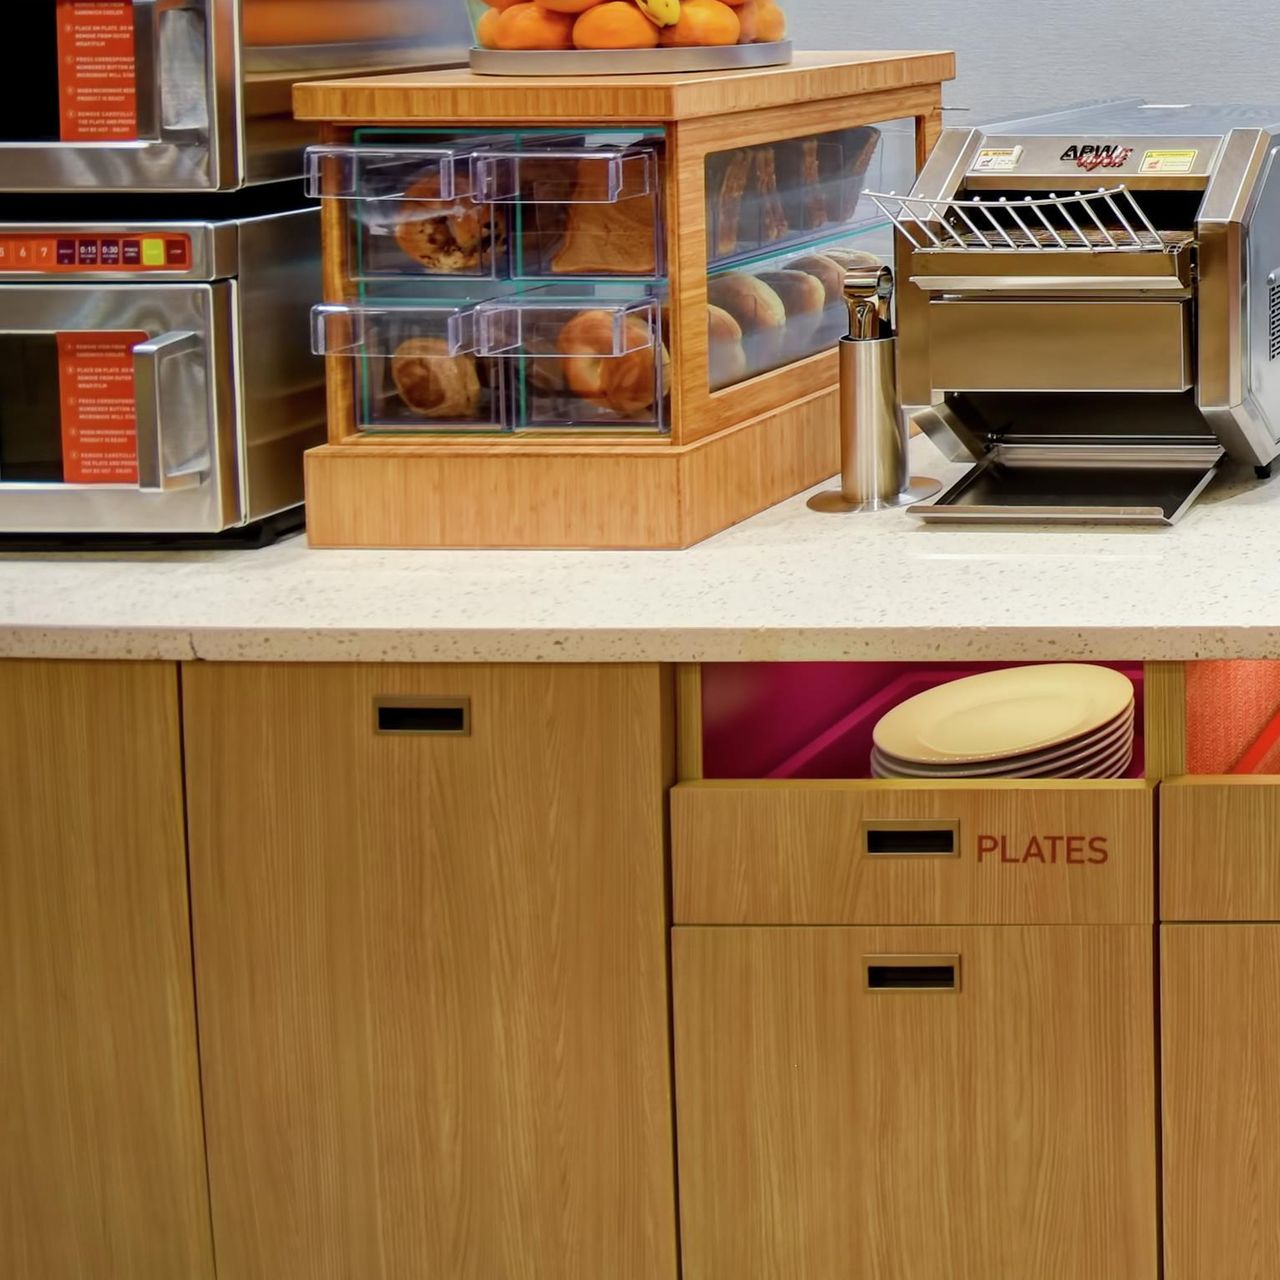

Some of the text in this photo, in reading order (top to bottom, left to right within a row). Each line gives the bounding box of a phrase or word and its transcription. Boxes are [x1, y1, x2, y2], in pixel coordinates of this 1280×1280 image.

[20, 246, 27, 257] 6
[41, 246, 48, 257] 7
[80, 246, 96, 254] 0:15
[102, 246, 119, 254] 0:30
[977, 834, 1109, 864] PLATES
